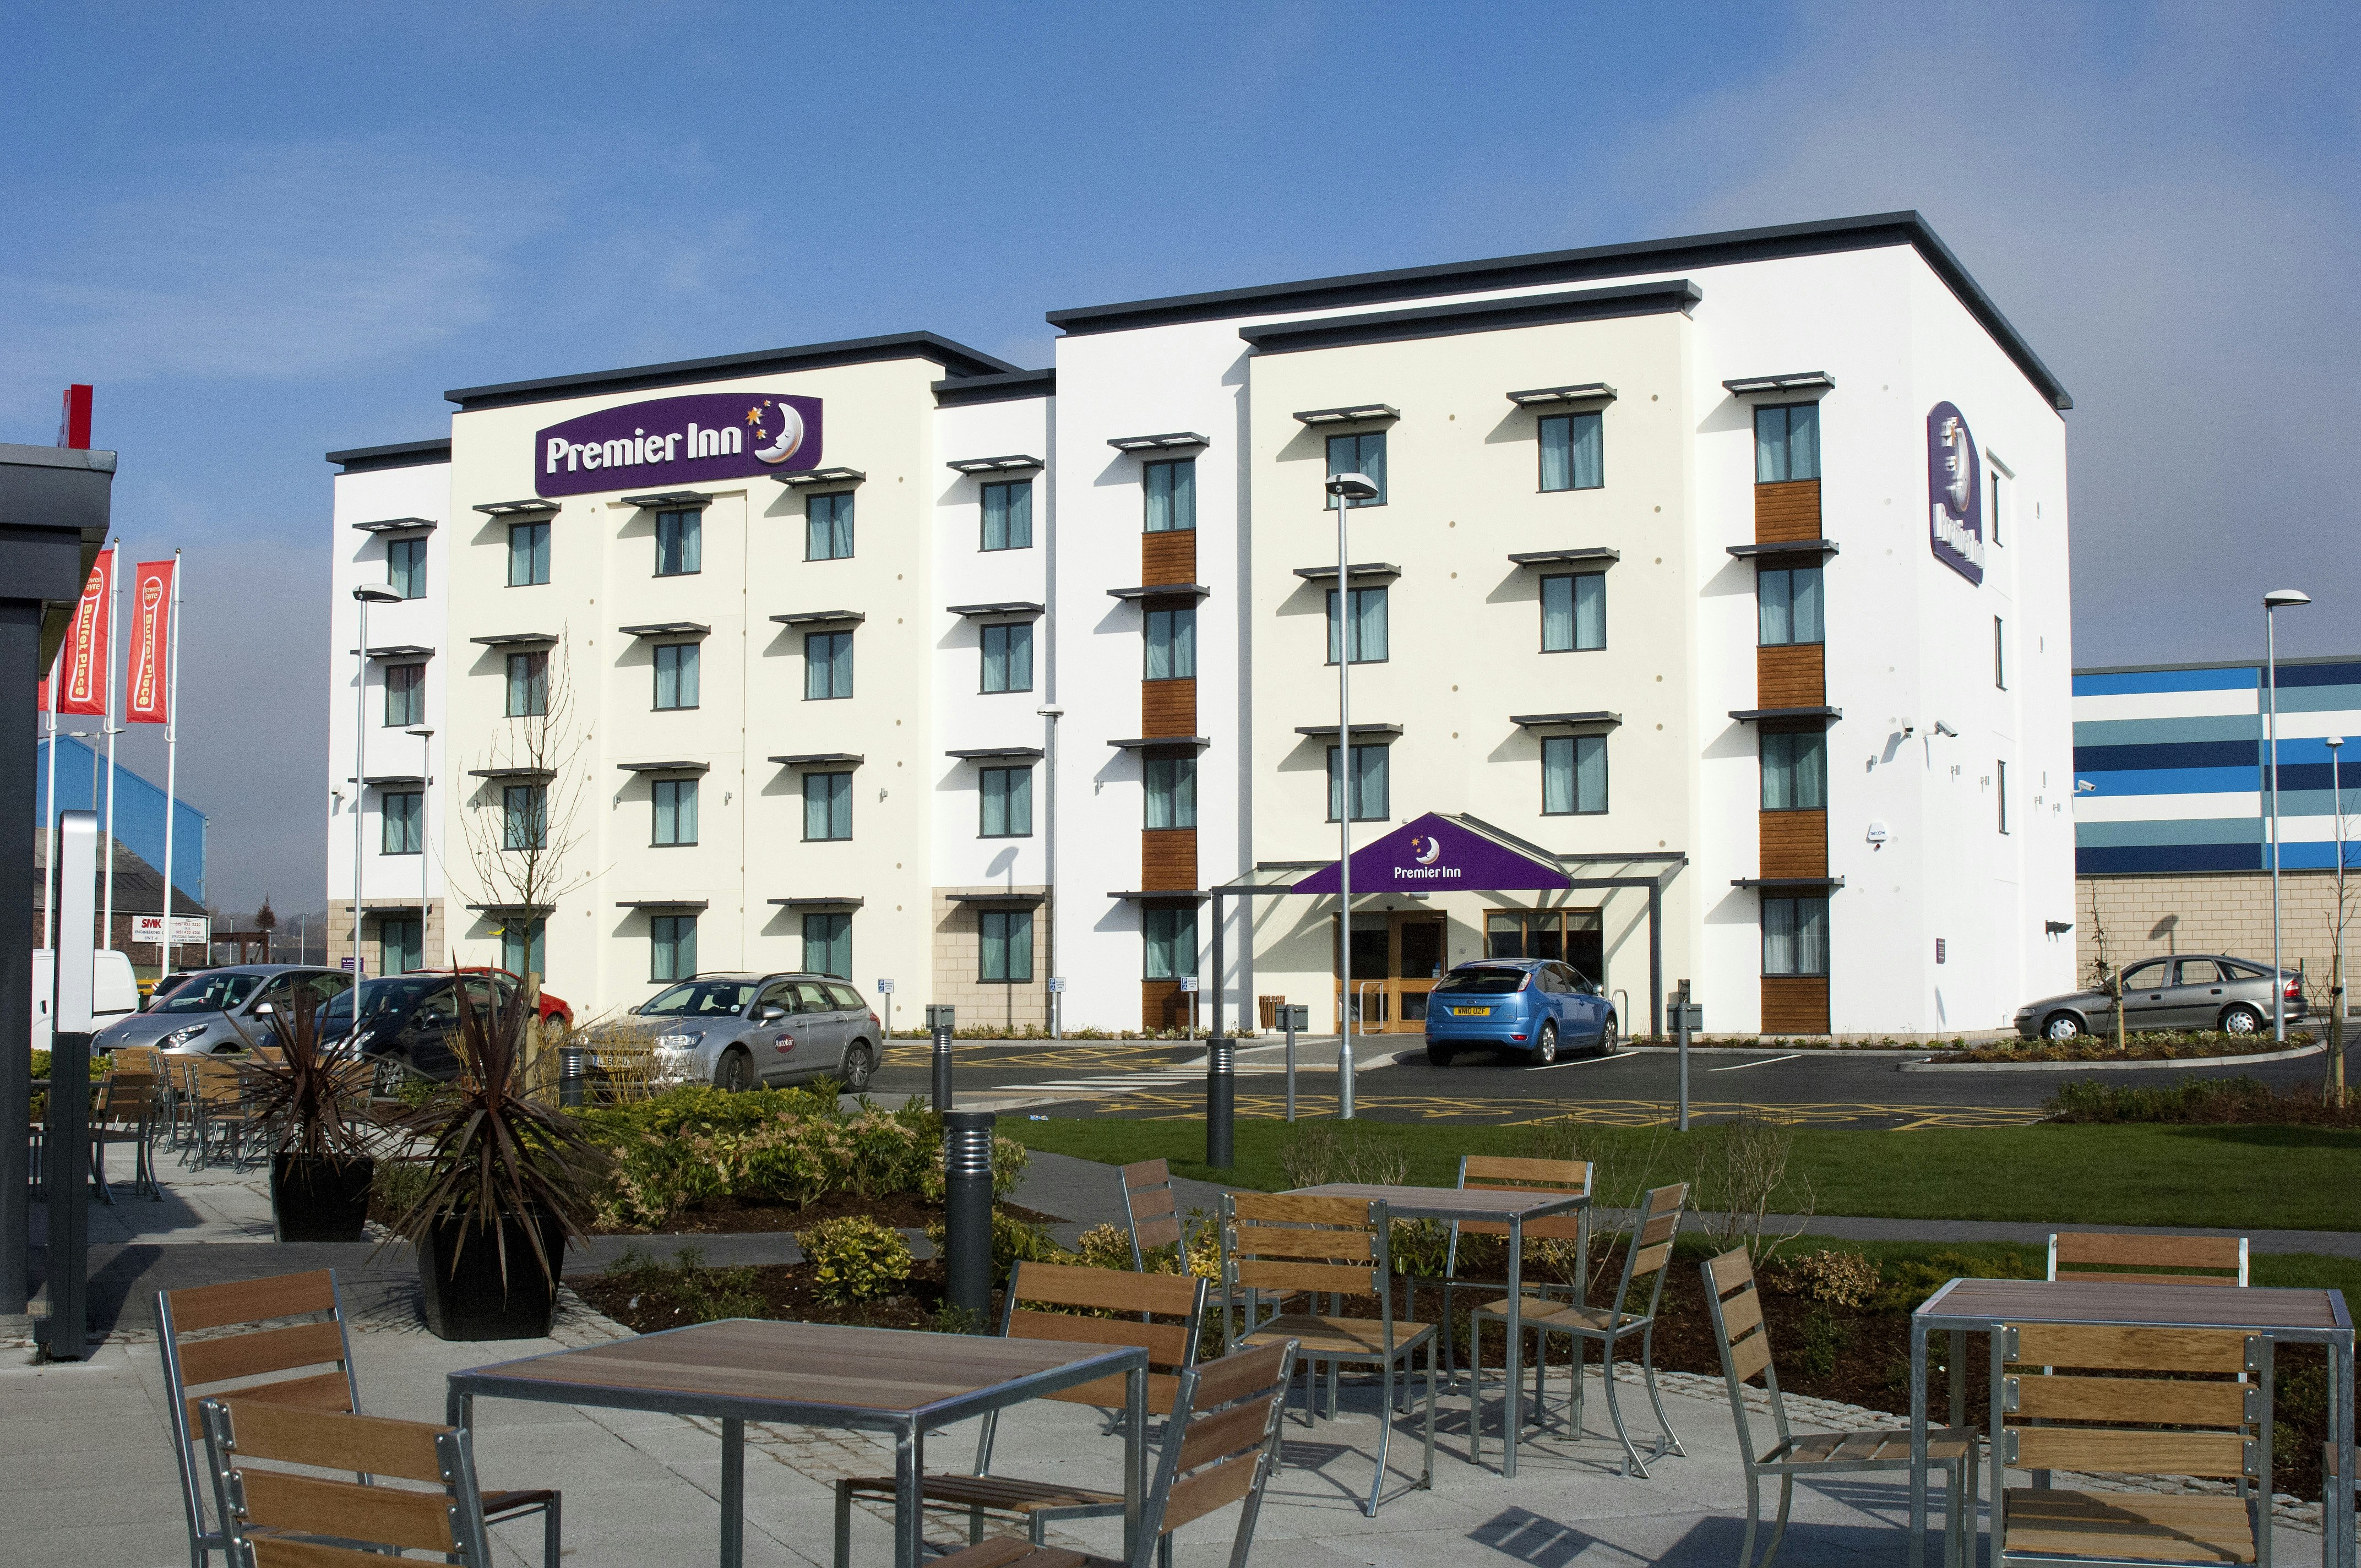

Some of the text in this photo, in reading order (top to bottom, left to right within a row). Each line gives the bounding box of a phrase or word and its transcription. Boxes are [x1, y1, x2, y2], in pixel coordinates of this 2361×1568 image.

[547, 422, 742, 474] Premier Inn
[86, 584, 100, 592] ayre
[75, 604, 93, 695] Buffet Place
[139, 664, 153, 705] Place
[1394, 865, 1461, 879] Premier Inn
[142, 918, 162, 928] SMK
[775, 1038, 793, 1047] Autobar
